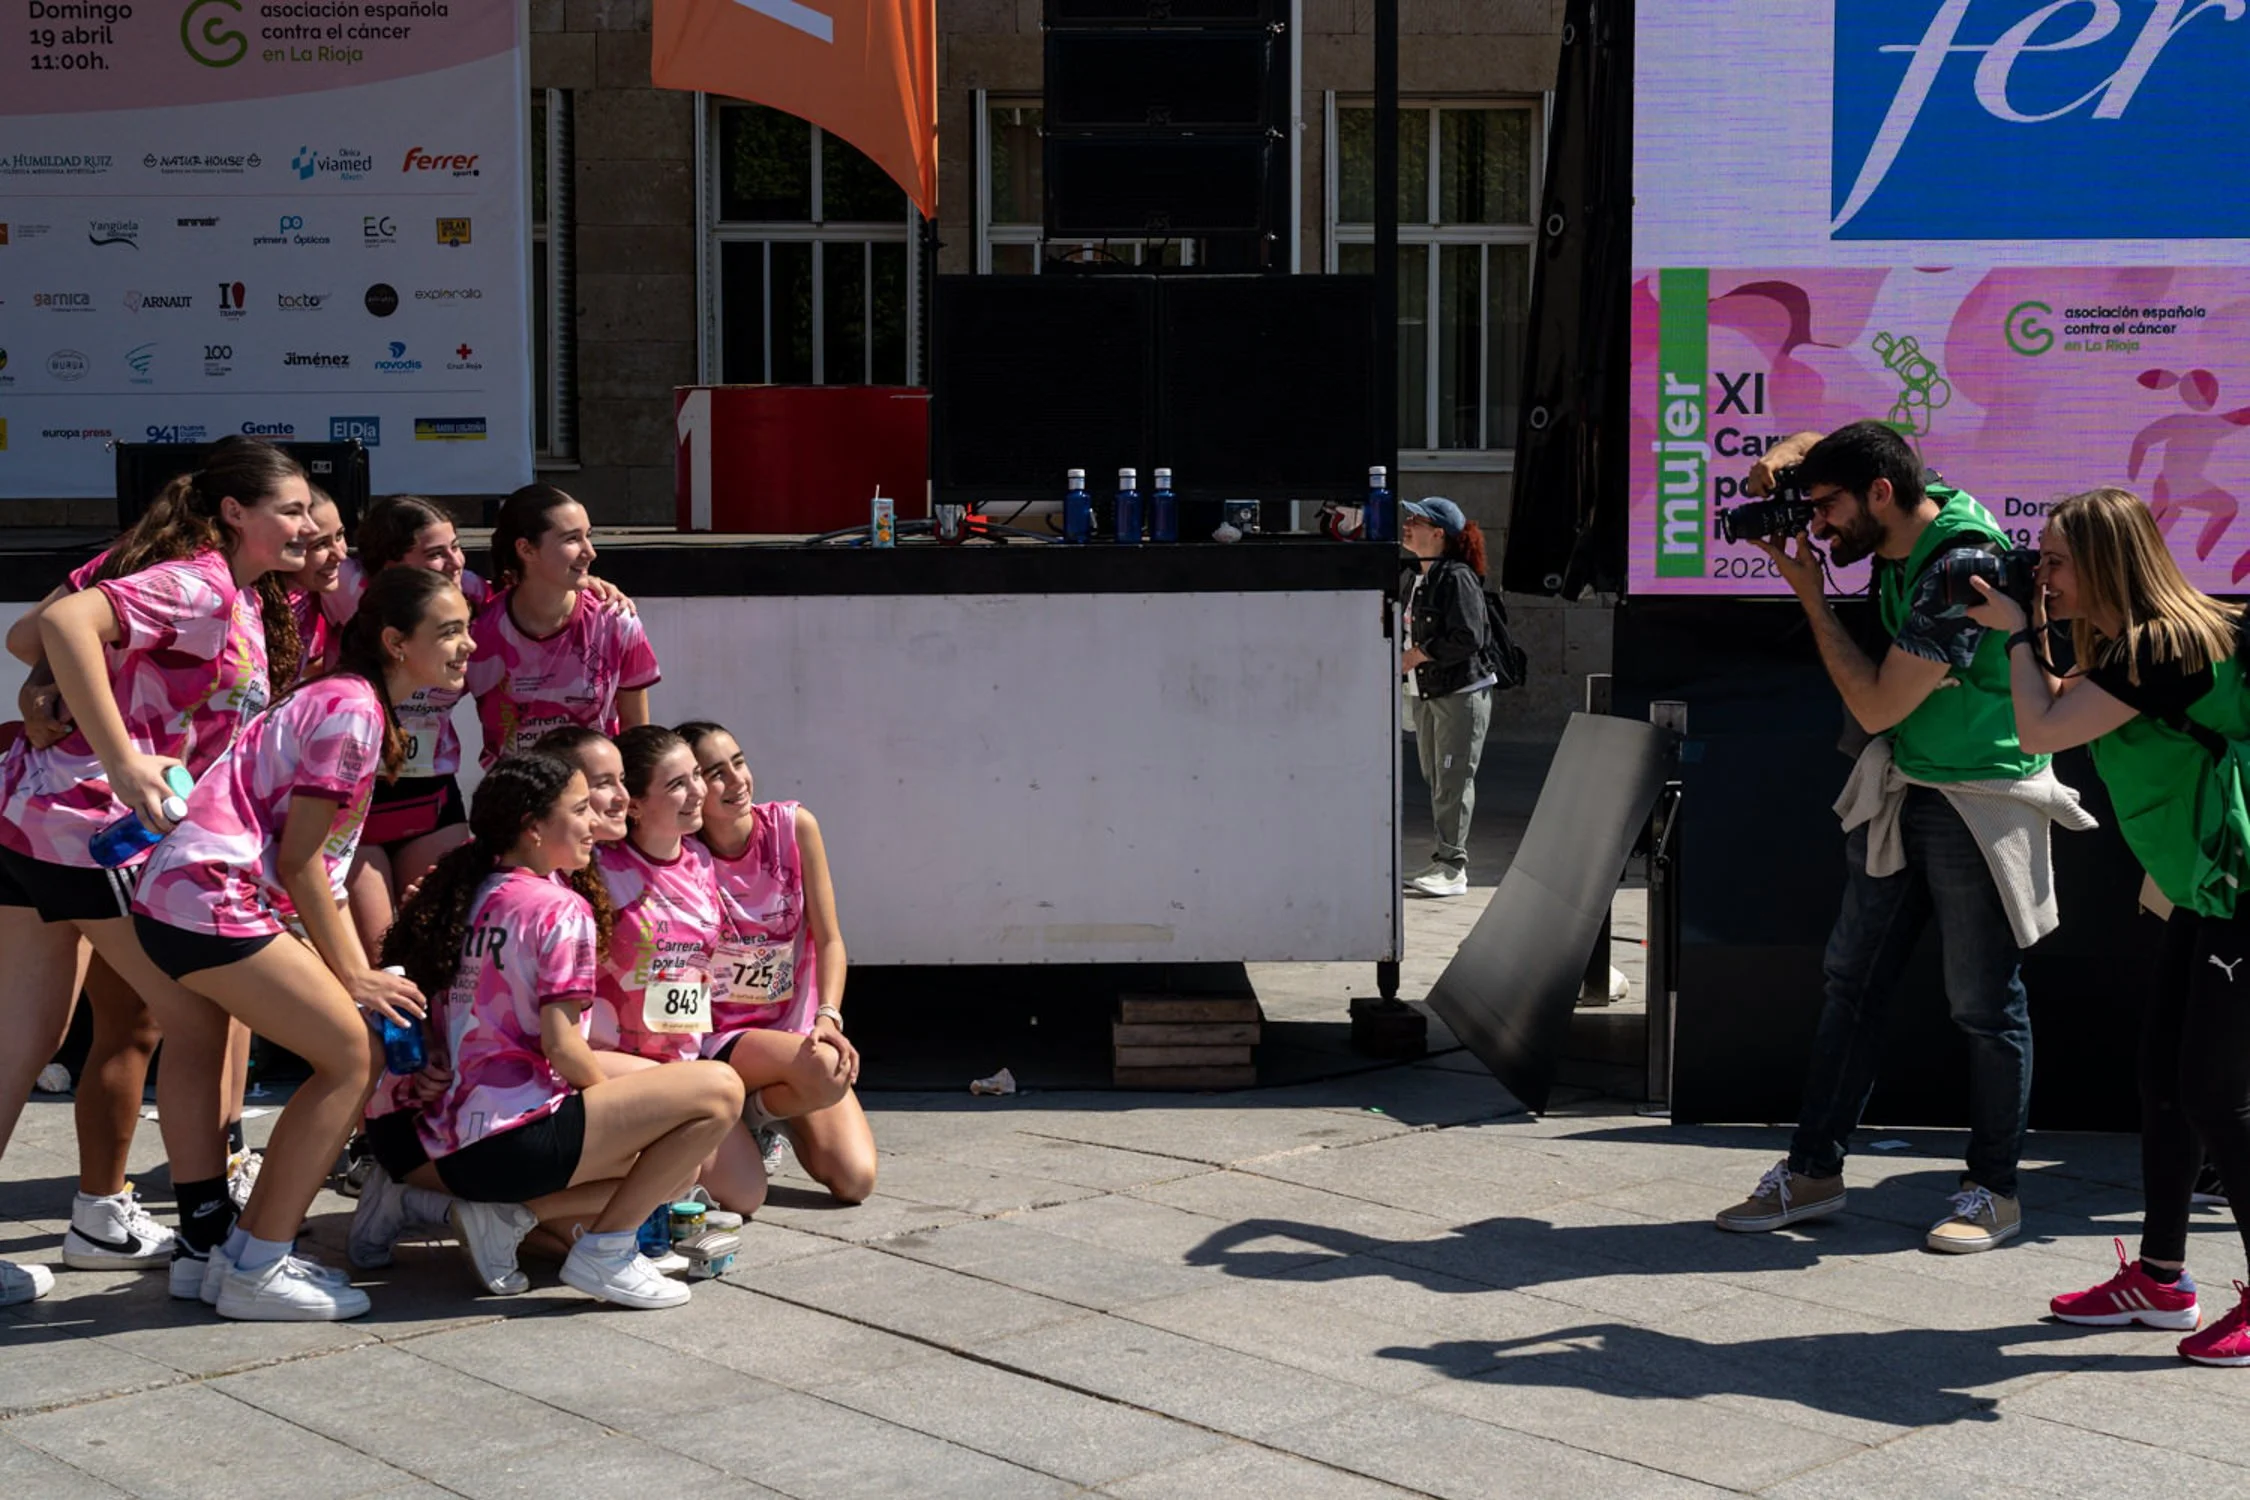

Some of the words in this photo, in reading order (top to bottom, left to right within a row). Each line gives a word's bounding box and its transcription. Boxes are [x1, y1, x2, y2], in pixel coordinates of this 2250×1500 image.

[29, 0, 132, 23] Domingo
[261, 0, 359, 18] asociación
[364, 0, 448, 21] española
[30, 28, 56, 47] 19
[62, 26, 114, 44] abril
[262, 25, 321, 40] contra
[326, 24, 342, 40] el
[347, 23, 411, 40] cáncer
[32, 51, 109, 70] 11:00h.
[262, 48, 285, 62] en
[291, 46, 312, 62] La
[317, 46, 363, 65] Rioja
[14, 153, 82, 168] HUMILDAD
[84, 155, 113, 168] RUIZ
[316, 155, 371, 172] viamed
[33, 291, 90, 308] garnica
[142, 296, 192, 309] ARNAUT
[277, 293, 320, 308] tacto
[2064, 305, 2139, 319] asociación
[2142, 304, 2206, 321] española
[2063, 322, 2110, 335] contra
[2112, 321, 2125, 335] el
[2127, 320, 2177, 335] cáncer
[204, 345, 233, 360] 100
[2064, 341, 2082, 352] en
[2085, 338, 2102, 352] La
[2105, 338, 2140, 354] Rioja
[283, 351, 350, 367] Jiménez
[375, 360, 422, 372] novodis
[1714, 372, 1764, 414] XI
[42, 430, 81, 440] europa
[82, 430, 112, 441] press
[241, 420, 294, 435] Gente
[1652, 372, 1712, 554] mujer
[1713, 557, 1785, 578] 2026
[656, 937, 701, 953] Carrera
[652, 957, 674, 971] por
[675, 954, 686, 968] la
[732, 962, 774, 988] 725
[664, 987, 699, 1016] 843
